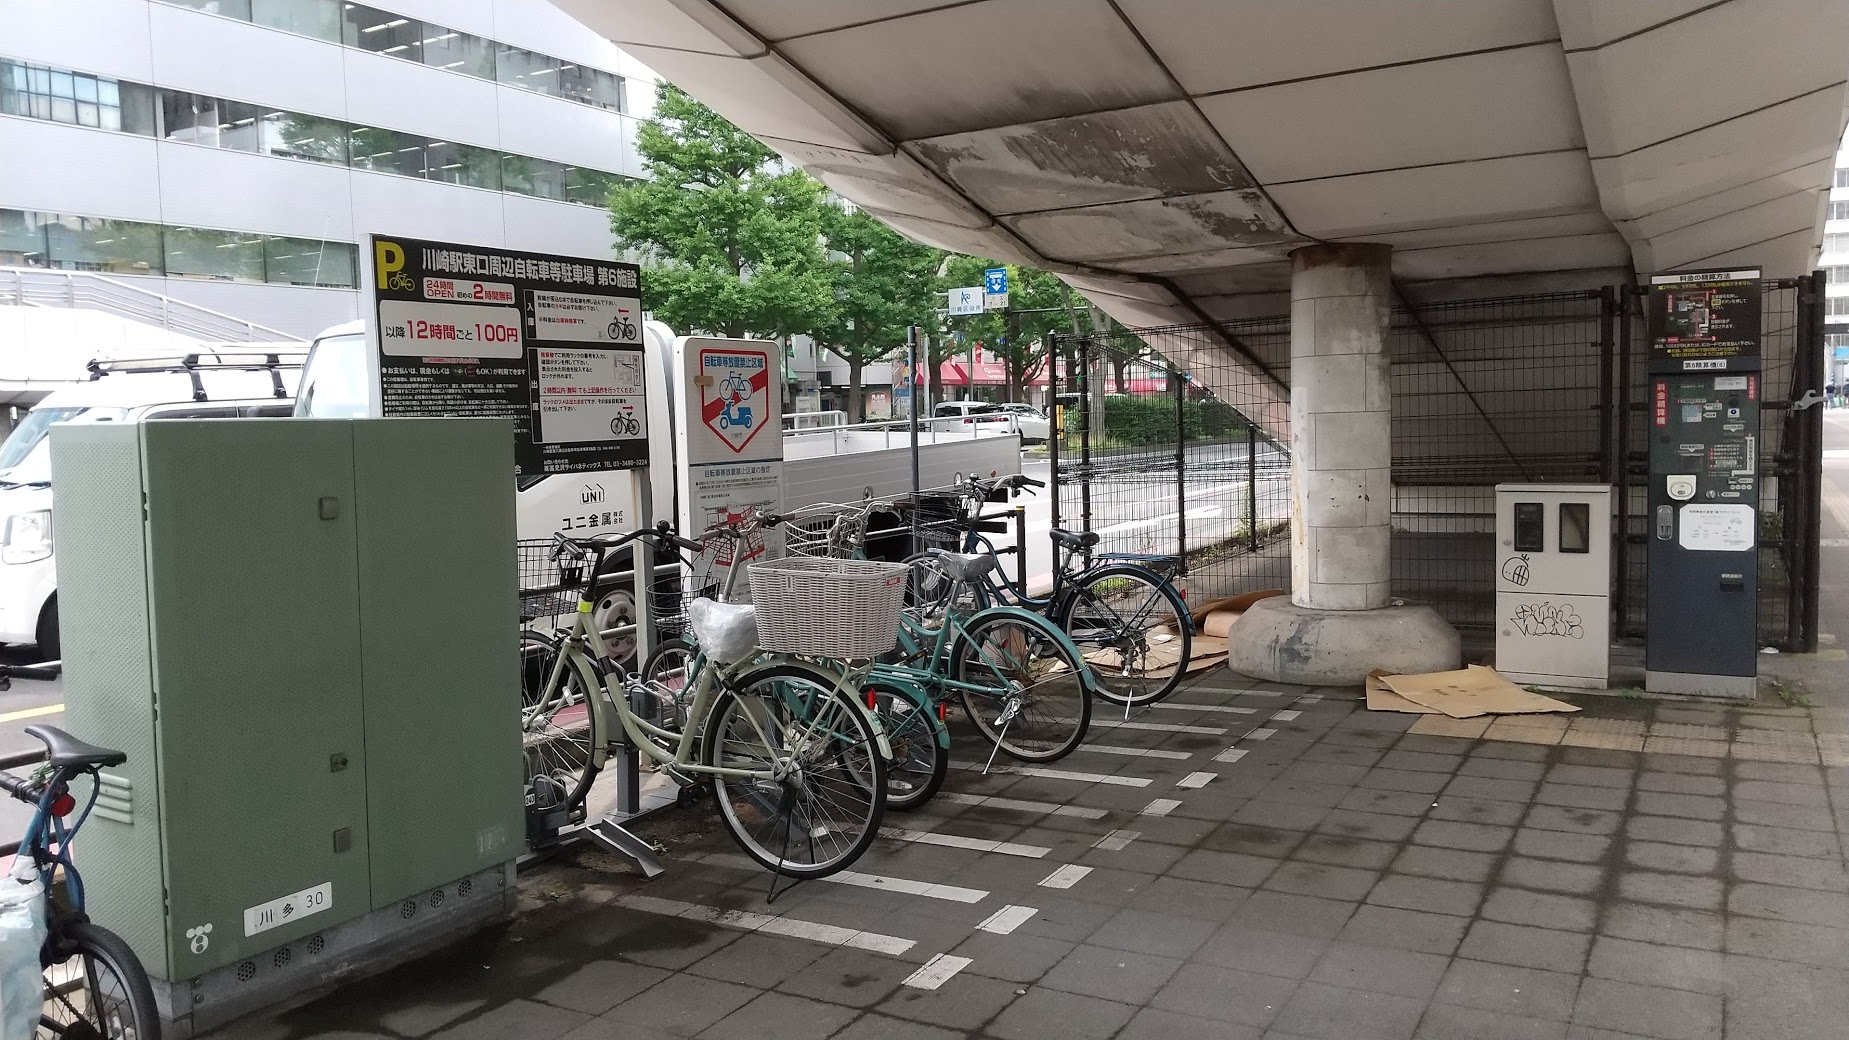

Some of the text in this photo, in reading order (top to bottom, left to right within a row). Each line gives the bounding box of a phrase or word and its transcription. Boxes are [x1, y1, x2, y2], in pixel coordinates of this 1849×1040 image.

[375, 240, 406, 290] P
[421, 247, 638, 289] 川崎駅東口周辺自転車等駐車場 第6施設
[426, 280, 454, 290] 24時間
[426, 289, 455, 299] OPEN
[950, 305, 981, 313] 川崎区役所
[385, 319, 518, 343] 以降12時間ごと100円
[704, 355, 765, 369] 自転車等放置禁止区域
[581, 490, 602, 503] UNI
[561, 511, 611, 531] ユニ金属
[305, 891, 324, 908] 30
